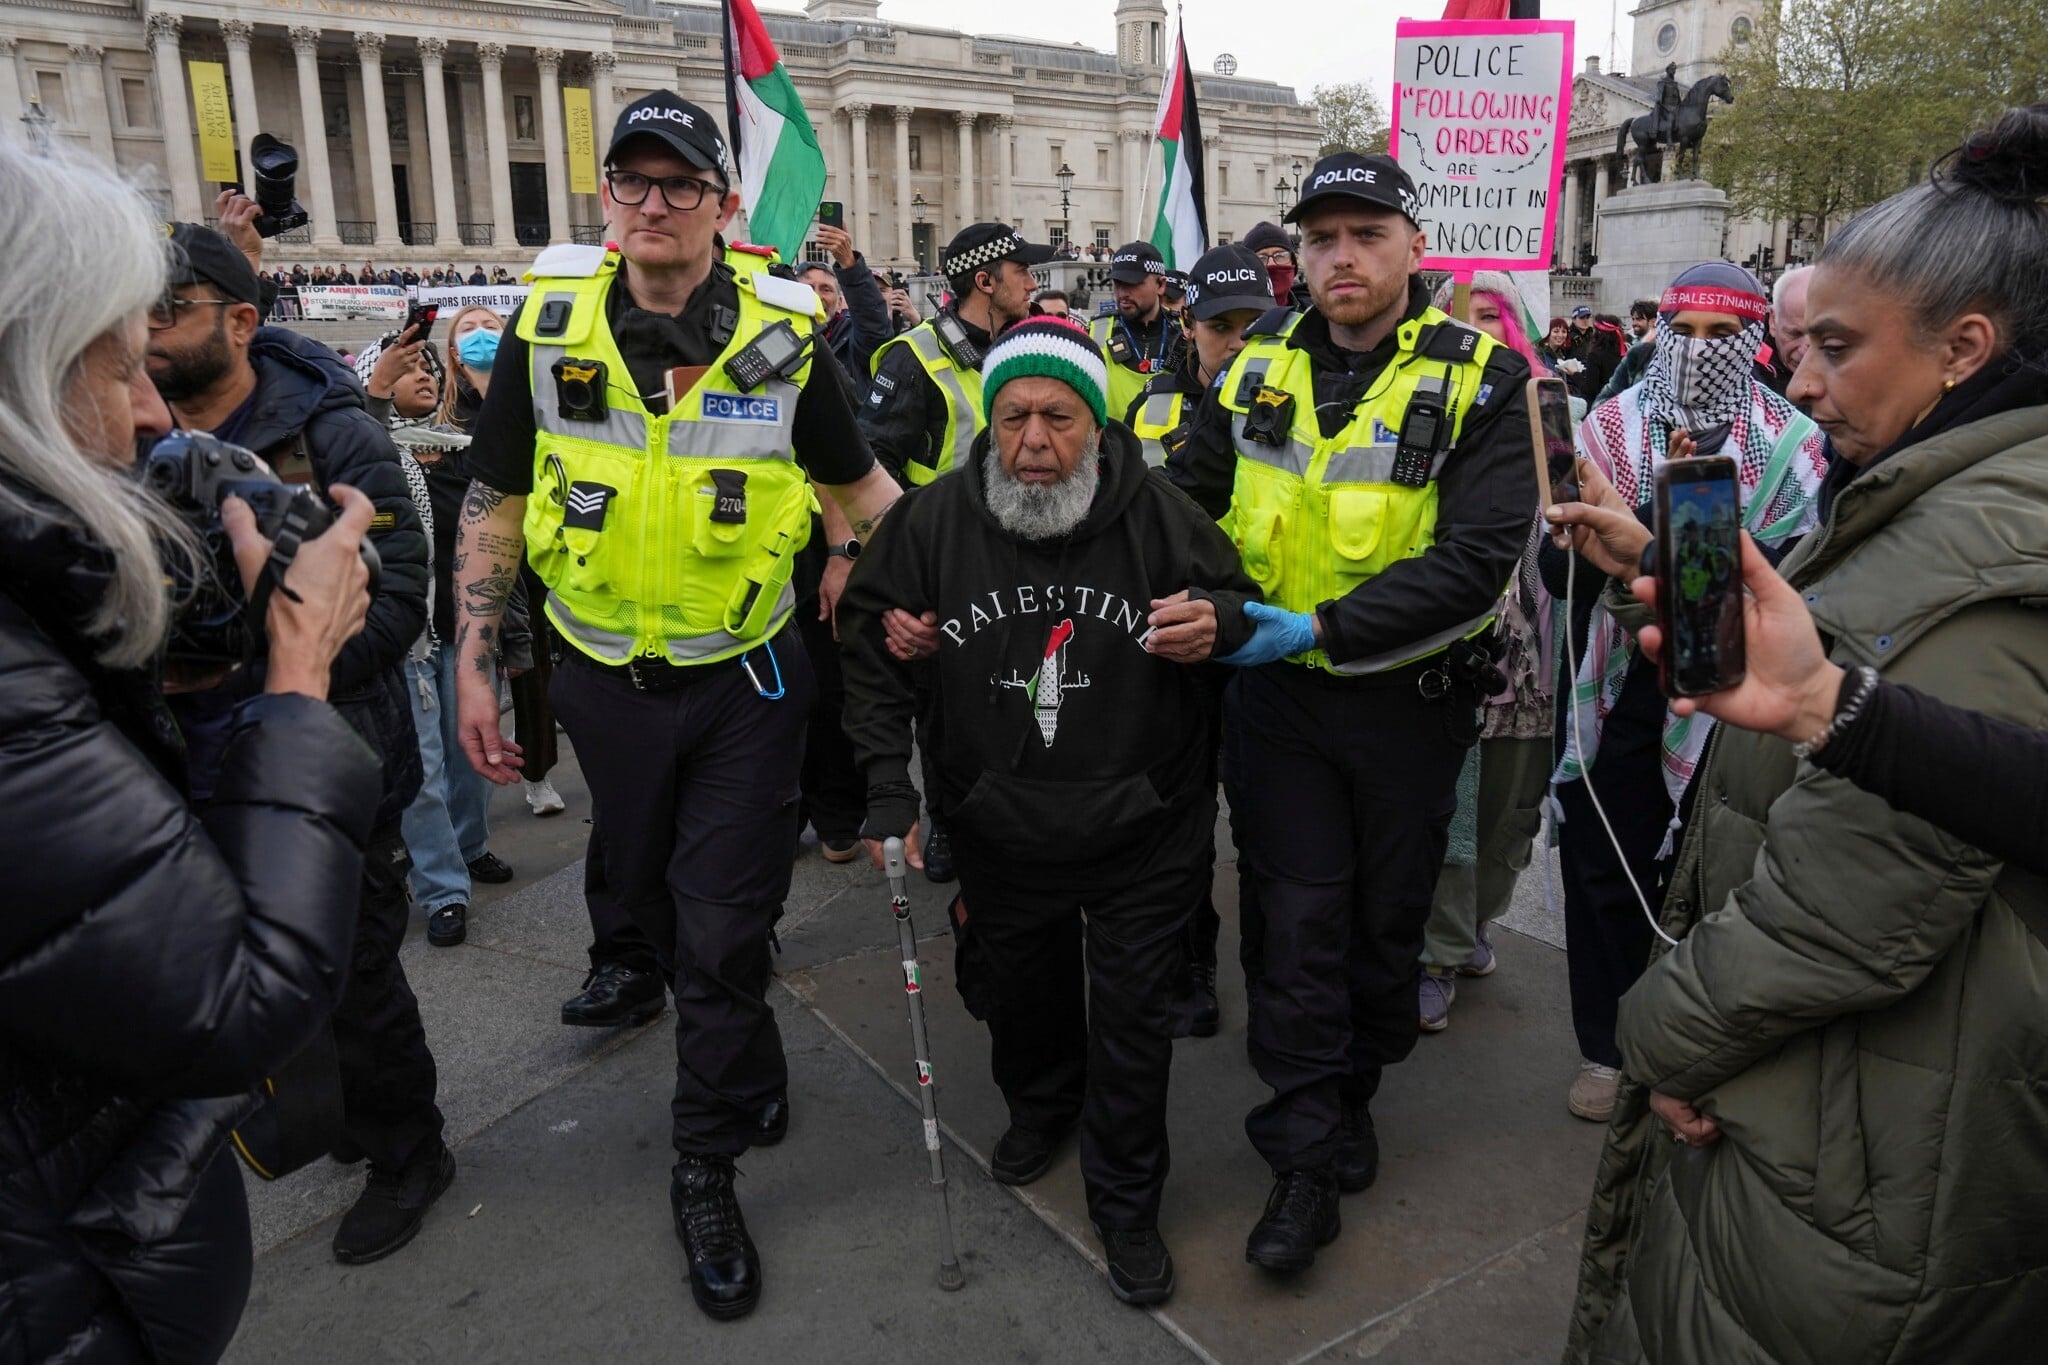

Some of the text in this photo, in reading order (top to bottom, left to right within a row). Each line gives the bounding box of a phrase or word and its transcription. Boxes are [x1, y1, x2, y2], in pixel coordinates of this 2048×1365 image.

[321, 1, 424, 22] NATIONAL
[438, 11, 523, 31] GALLERY
[1416, 45, 1524, 80] POLICE
[201, 81, 217, 138] NATIONAL
[211, 82, 228, 139] GALLERY
[628, 106, 694, 129] POLICE
[580, 106, 591, 156] GALLERY
[1313, 168, 1377, 190] POLICE
[1447, 162, 1477, 176] ARE
[1416, 182, 1547, 210] OMPLICIT IN
[1418, 218, 1542, 254] ENOCIDE
[1113, 254, 1138, 264] POLICE
[1207, 268, 1257, 285] POLICE
[329, 286, 369, 295] ARMING
[371, 287, 404, 296] ISRAEL
[461, 295, 498, 307] DESERVE
[500, 294, 510, 306] TO
[1678, 292, 1752, 310] PALESTINIAN
[1460, 334, 1475, 351] 9133
[706, 397, 774, 417] POLICE
